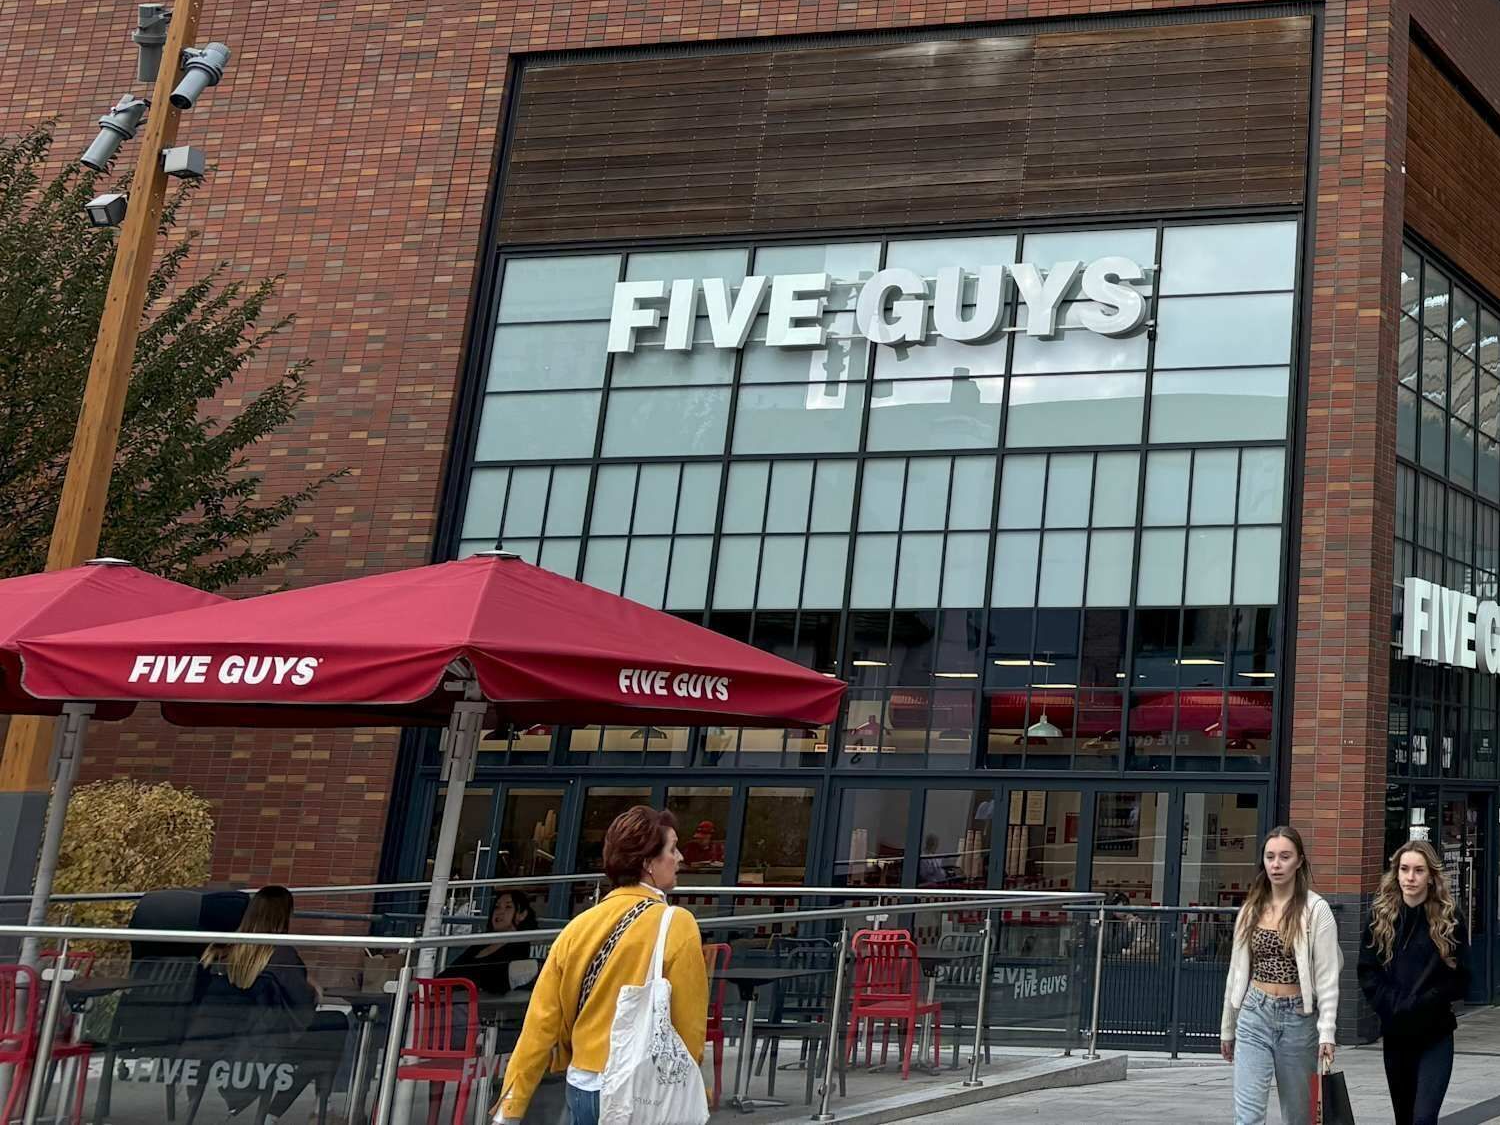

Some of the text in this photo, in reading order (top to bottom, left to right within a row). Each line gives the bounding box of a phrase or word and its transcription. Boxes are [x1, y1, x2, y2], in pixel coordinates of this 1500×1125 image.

[607, 256, 1148, 353] FIVE GUYS
[1402, 577, 1477, 669] FIVE
[128, 654, 319, 686] FIVE GUYS
[618, 668, 729, 701] FIVE GUYS
[1014, 975, 1067, 999] FIVE GUYS
[208, 1060, 297, 1091] GUYS
